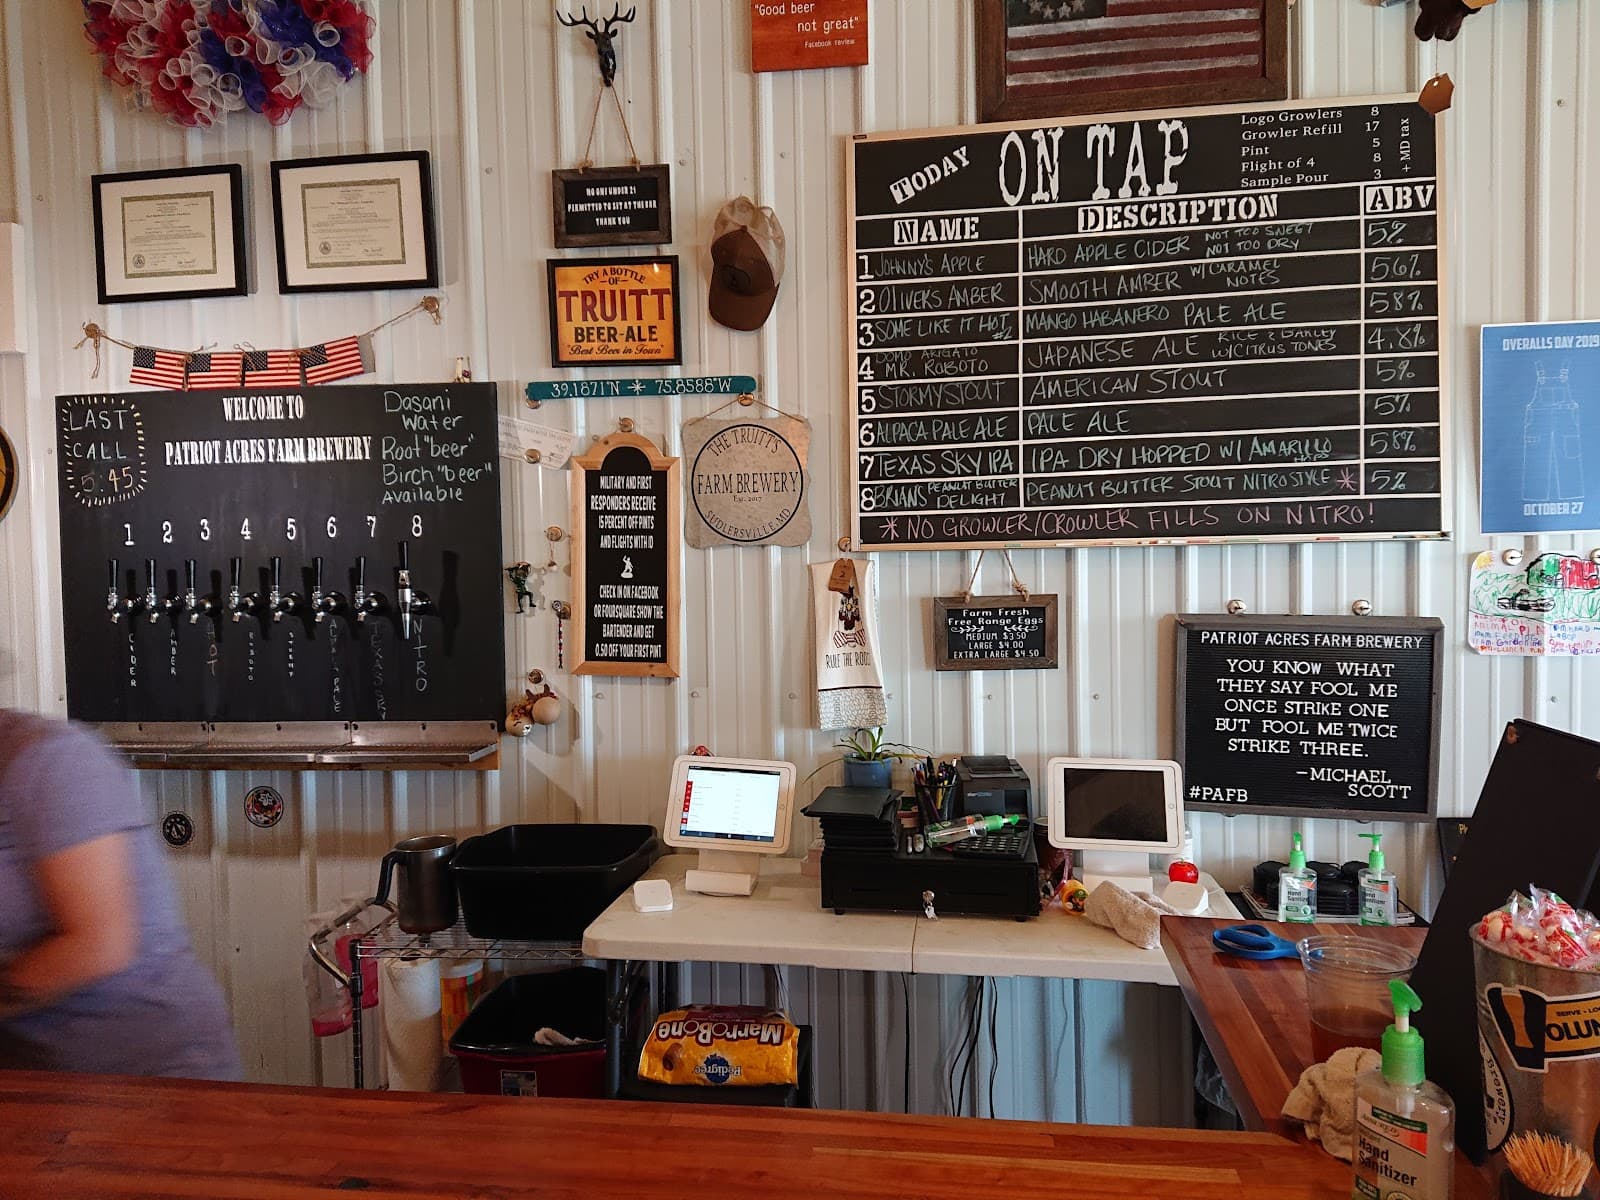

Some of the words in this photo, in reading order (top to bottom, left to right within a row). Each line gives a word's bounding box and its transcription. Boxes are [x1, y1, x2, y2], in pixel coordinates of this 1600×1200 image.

[754, 3, 785, 17] "Good
[791, 2, 815, 14] beer
[797, 19, 817, 32] not
[823, 16, 859, 34] great"
[804, 40, 832, 49] Facebook
[1241, 114, 1276, 128] Logo
[1278, 108, 1343, 123] Growlers
[1370, 106, 1380, 117] 8
[1400, 118, 1410, 137] tax
[1241, 127, 1300, 142] Growler
[1302, 123, 1343, 137] Refill
[1365, 120, 1381, 133] 17
[1241, 144, 1270, 157] Pint
[1372, 137, 1381, 149] 5
[1399, 139, 1411, 161] MD
[999, 127, 1064, 206] ON
[1086, 120, 1189, 201] TAP
[1241, 159, 1285, 174] Flight
[1287, 157, 1302, 169] of
[1306, 157, 1316, 168] 4
[1373, 152, 1382, 163] 8
[889, 145, 971, 205] TODAY
[1241, 175, 1292, 190] Sample
[1295, 171, 1329, 185] Pour
[1373, 168, 1382, 180] 3
[595, 217, 616, 227] THANK
[617, 216, 631, 226] YOU
[894, 216, 979, 245] NAME
[1077, 193, 1278, 235] DESCRIPTION
[1365, 184, 1435, 213] ABV
[858, 254, 875, 279] 1
[1028, 243, 1067, 267] HARD
[1073, 242, 1128, 262] APPLE
[1133, 235, 1191, 261] CIDER
[609, 266, 647, 284] BOTTLE
[859, 289, 876, 314] 2
[1028, 279, 1108, 306] SMOOTH
[1116, 270, 1182, 298] AMBER
[558, 287, 671, 323] TRUITT
[574, 325, 658, 343] BEER-ALE
[858, 321, 875, 347] 3
[1025, 311, 1077, 333] MANGO
[1082, 304, 1171, 330] HABANERO
[1183, 305, 1232, 327] PALE
[1242, 301, 1287, 321] ALE
[1502, 336, 1553, 352] OVERALLS
[1554, 335, 1575, 349] DAY
[1575, 334, 1600, 348] 2019
[857, 355, 875, 381] 4
[1027, 339, 1136, 369] JAPANESE
[1151, 335, 1200, 362] ALE
[384, 388, 452, 413] Dasani
[860, 388, 876, 413] 5
[1029, 373, 1139, 404] AMERICAN
[1146, 368, 1228, 395] STOUT
[222, 395, 283, 421] WELCOME
[286, 395, 304, 420] TO
[69, 408, 129, 431] LAST
[860, 422, 875, 447] 6
[1027, 412, 1078, 436] PALE
[1086, 409, 1131, 433] ALE
[72, 442, 127, 460] CALL
[164, 440, 221, 465] PATRIOT
[223, 439, 266, 464] ACRES
[267, 437, 307, 463] FARM
[306, 436, 372, 463] BREWERY
[381, 434, 421, 461] Root
[423, 433, 475, 459] "beer"
[706, 433, 732, 457] THE
[731, 427, 782, 454] TRUITT'S
[860, 455, 875, 479] 7
[1031, 446, 1070, 472] IPA
[1131, 443, 1211, 466] HOPPED
[1249, 435, 1333, 457] AMARILLO
[80, 465, 134, 494] 5:45
[382, 462, 434, 486] Birch
[600, 475, 626, 490] MILITARY
[697, 473, 733, 495] FARM
[736, 471, 799, 494] BREWERY
[382, 487, 465, 505] Available
[590, 495, 631, 511] RESPONDERS
[631, 495, 657, 511] RECEIVE
[860, 487, 876, 512] 8
[1026, 480, 1096, 501] PEANUT
[1101, 475, 1174, 496] BUTTER
[1179, 474, 1236, 493] STOUT
[776, 507, 792, 525] MD
[1523, 502, 1571, 517] OCTOBER
[1570, 501, 1585, 515] 27
[123, 523, 135, 546] 1
[162, 520, 173, 543] 2
[199, 518, 211, 541] 3
[240, 517, 252, 540] 4
[286, 517, 297, 540] 5
[326, 515, 337, 538] 6
[366, 515, 377, 538] 7
[411, 514, 423, 537] 8
[605, 515, 628, 529] PERCENT
[907, 517, 936, 541] NO
[1147, 505, 1220, 532] FILLS
[1236, 507, 1272, 525] ON
[1286, 502, 1375, 526] NITRO!
[611, 535, 633, 549] FLIGHTS
[631, 585, 659, 600] FACEBOOK
[601, 604, 637, 619] FOURSQUARE
[948, 618, 972, 626] Free
[978, 617, 1012, 627] Range
[1017, 616, 1044, 627] Eggs
[962, 609, 992, 617] Farm
[998, 607, 1030, 616] Fresh
[602, 623, 633, 639] BARTENDER
[965, 632, 998, 641] MEDIUM
[1201, 631, 1259, 646] PATRIOT
[1264, 631, 1310, 647] ACRES
[1314, 633, 1352, 648] FARM
[1356, 634, 1424, 650] BREWERY
[412, 618, 428, 692] NITRO
[953, 650, 980, 659] EXTRA
[984, 649, 1009, 658] LARGE
[968, 641, 993, 650] LARGE
[1226, 658, 1265, 674] YOU
[1272, 659, 1322, 676] KNOW
[1336, 661, 1396, 678] WHAT
[1216, 678, 1267, 694] THEY
[1269, 680, 1305, 695] SAY
[1310, 681, 1358, 697] FOOL
[1368, 683, 1398, 698] ME
[1224, 698, 1278, 714] ONCE
[1283, 700, 1342, 717] STRIKE
[1348, 703, 1390, 719] ONE
[1215, 717, 1251, 733] BUT
[1262, 719, 1309, 736] FOOL
[1317, 721, 1344, 737] ME
[1348, 722, 1398, 739] TWICE
[1228, 738, 1291, 754] STRIKE
[1299, 740, 1369, 758] THREE.
[1189, 786, 1249, 803] #PAFB
[1347, 784, 1413, 800] SCOTT
[694, 1064, 742, 1078] Pedigree
[1358, 1137, 1390, 1163] Hand
[1358, 1151, 1419, 1187] Sanitizer
